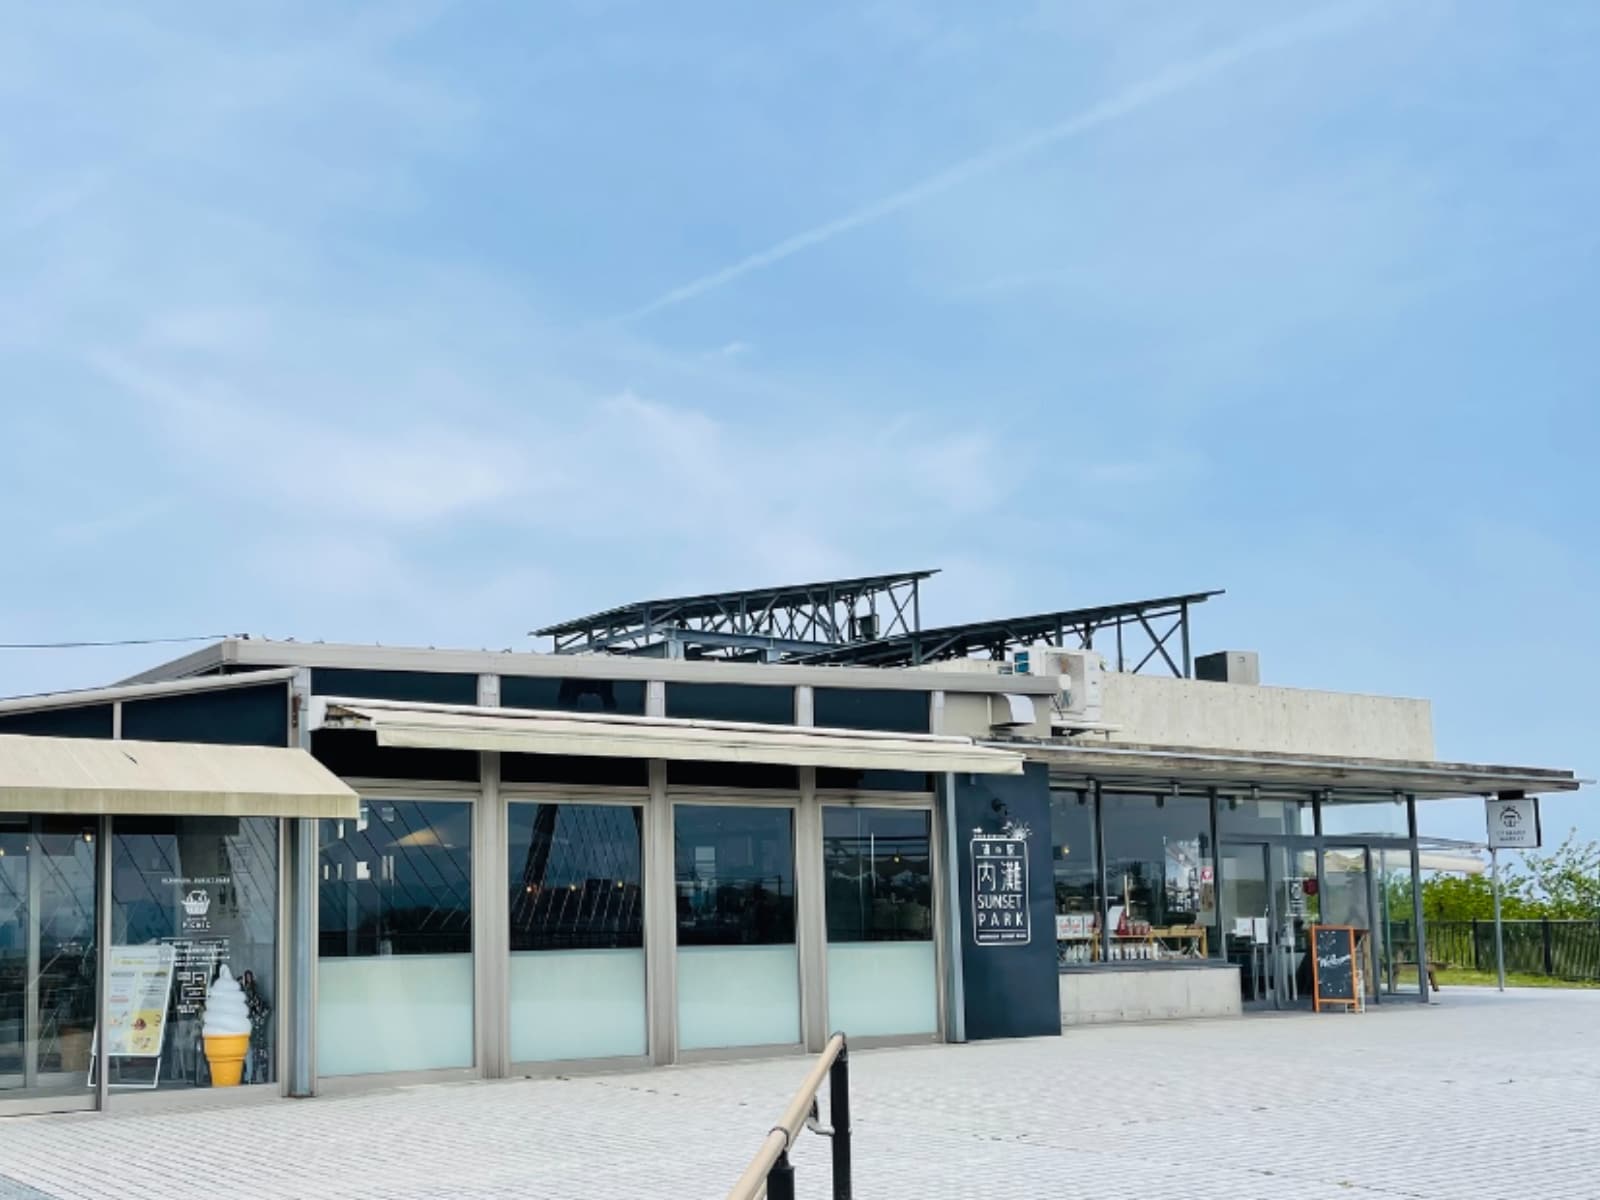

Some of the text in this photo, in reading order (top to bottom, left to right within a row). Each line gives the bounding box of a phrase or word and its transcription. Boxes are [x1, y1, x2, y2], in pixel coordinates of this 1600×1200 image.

[977, 861, 1022, 892] 内灘
[977, 894, 1023, 909] SUNSET
[978, 911, 1024, 927] PARK
